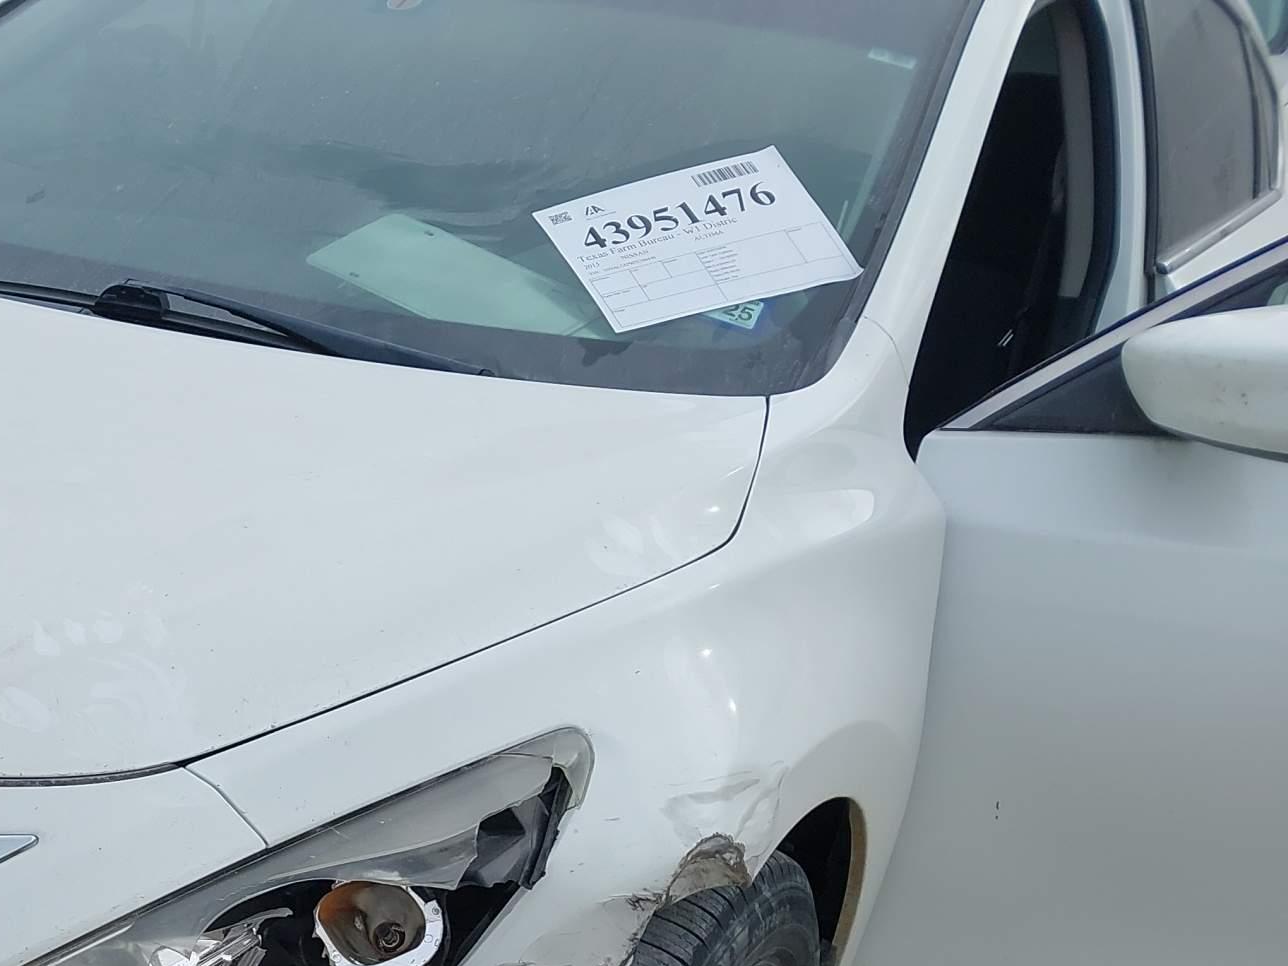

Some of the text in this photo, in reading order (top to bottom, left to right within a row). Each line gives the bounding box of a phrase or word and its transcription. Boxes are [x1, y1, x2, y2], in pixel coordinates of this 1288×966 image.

[584, 181, 777, 250] 43951476
[577, 251, 609, 263] Texas
[609, 243, 637, 255] Farm
[638, 233, 675, 248] Bureau
[722, 304, 755, 321] 25
